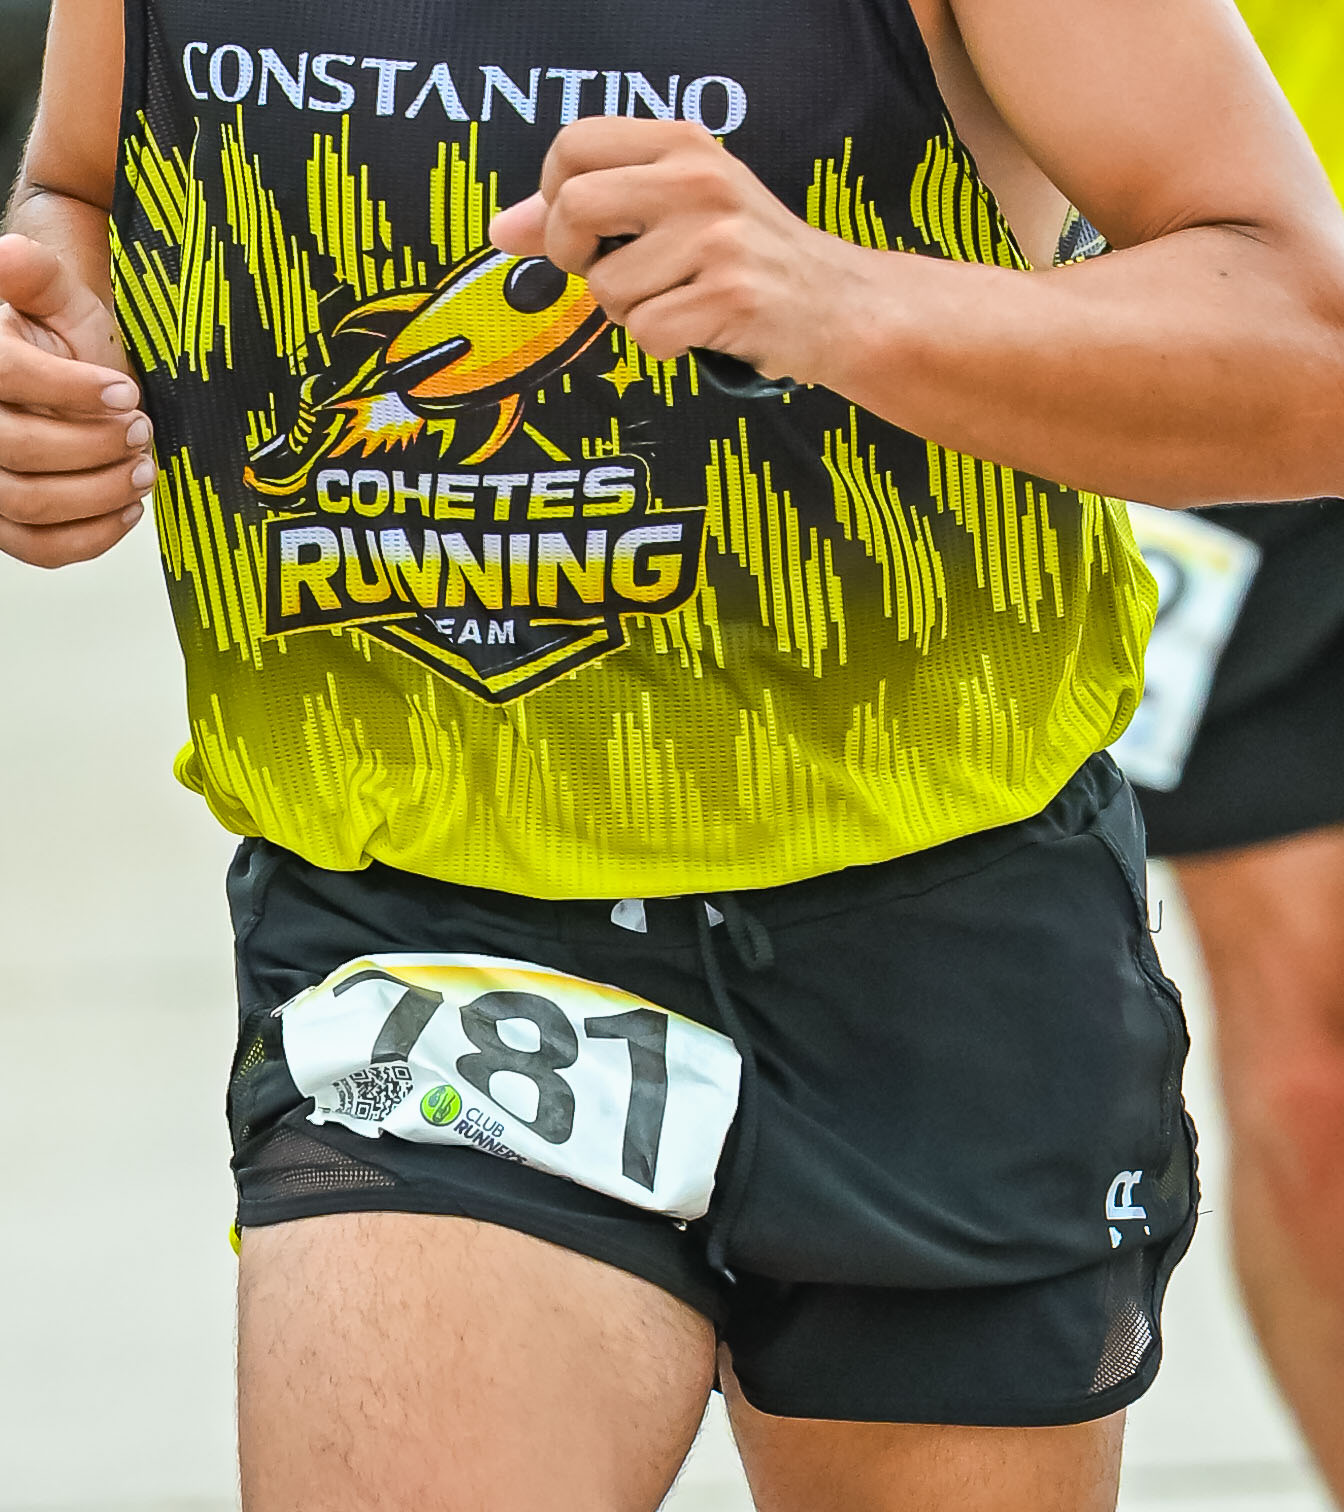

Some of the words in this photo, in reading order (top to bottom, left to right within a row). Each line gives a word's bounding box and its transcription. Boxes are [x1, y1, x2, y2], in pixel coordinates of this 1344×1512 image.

[182, 41, 748, 135] CONSTANTINO
[315, 465, 638, 522] COHETES
[279, 522, 684, 618] RUNNING
[424, 614, 516, 645] EAM
[333, 969, 669, 1193] 781
[465, 1107, 505, 1138] CLUB
